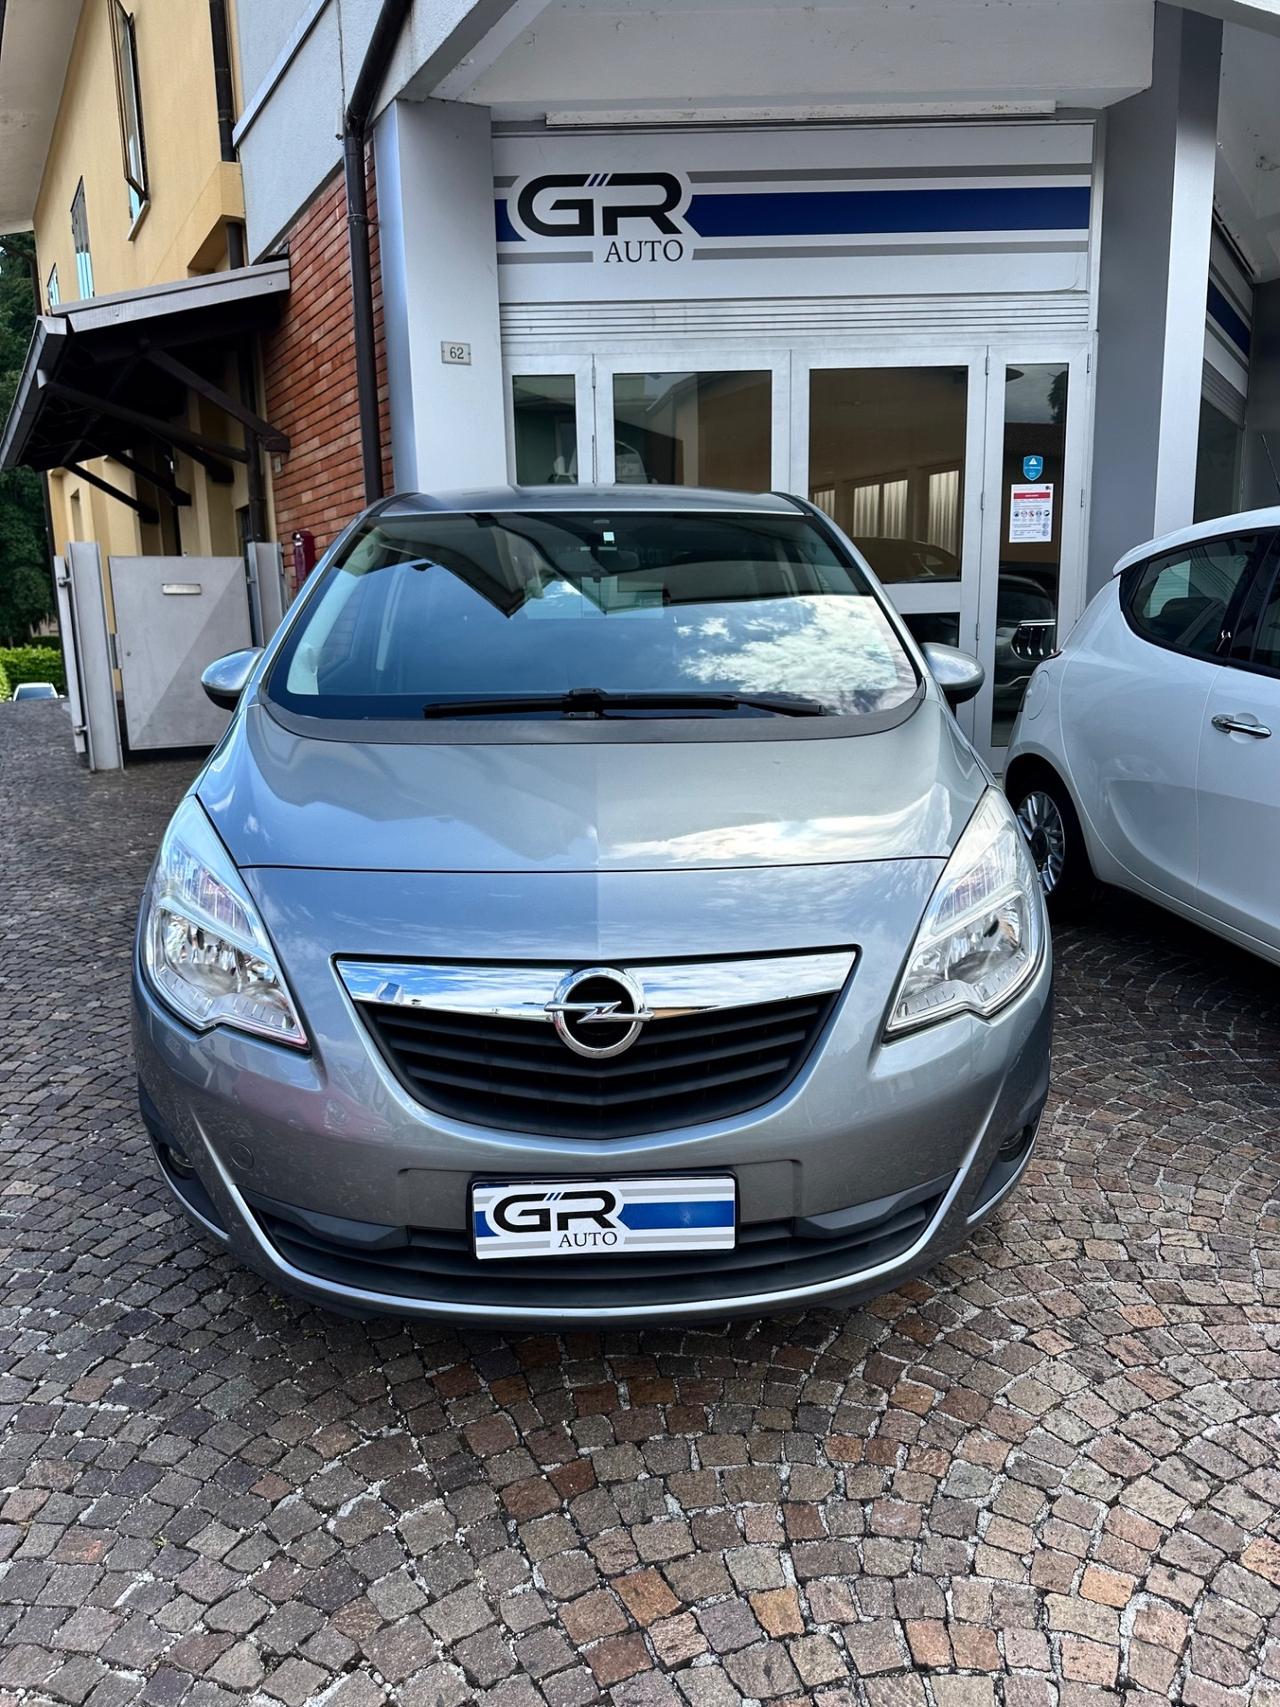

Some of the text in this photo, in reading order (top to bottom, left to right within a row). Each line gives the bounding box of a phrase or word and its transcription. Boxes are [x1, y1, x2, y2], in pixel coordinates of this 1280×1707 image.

[603, 239, 684, 263] AUTO
[450, 346, 464, 359] 62
[558, 1231, 618, 1248] AUTO
